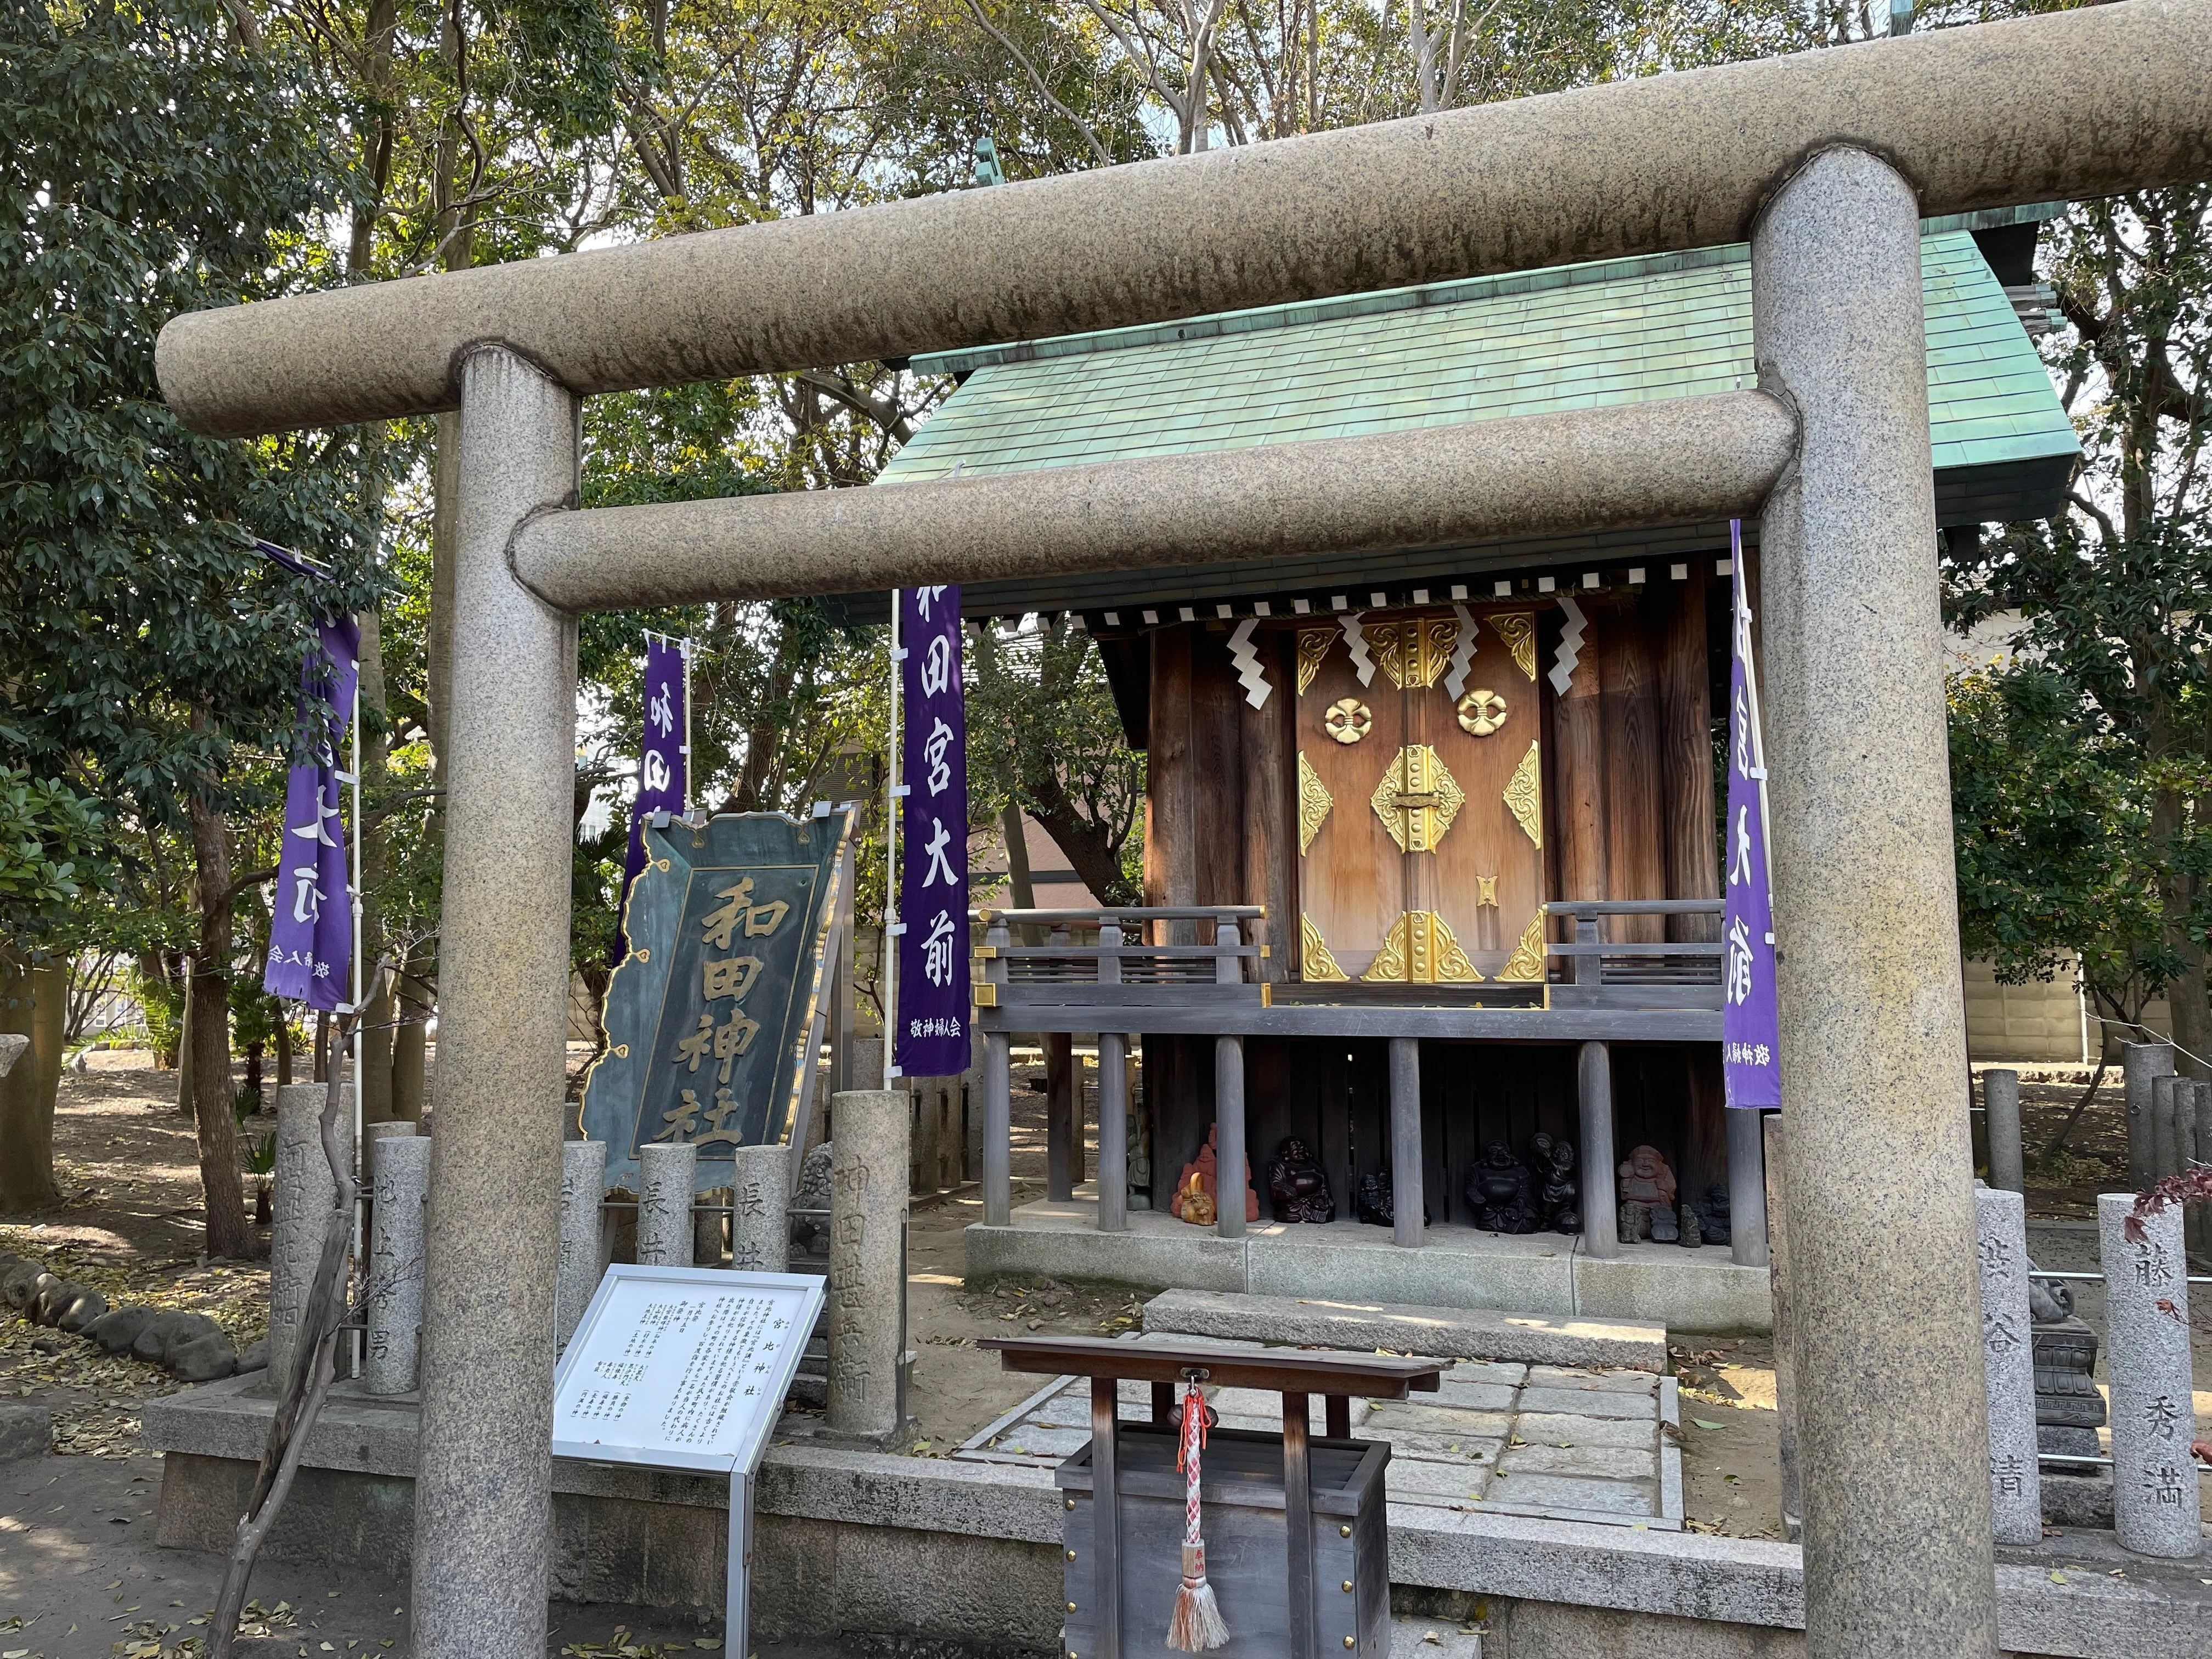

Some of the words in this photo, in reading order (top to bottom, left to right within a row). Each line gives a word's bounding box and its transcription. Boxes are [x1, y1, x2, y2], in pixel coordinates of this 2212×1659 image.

[652, 877, 790, 1147] 和田神社
[910, 1016, 961, 1038] 敬神婦人会
[673, 1300, 688, 1322] 御祭神
[679, 1306, 695, 1333] 一月十五日
[691, 1301, 706, 1322] 宮比祭
[743, 1318, 784, 1396] 宮比神社
[1194, 1549, 1204, 1573] 奉納
